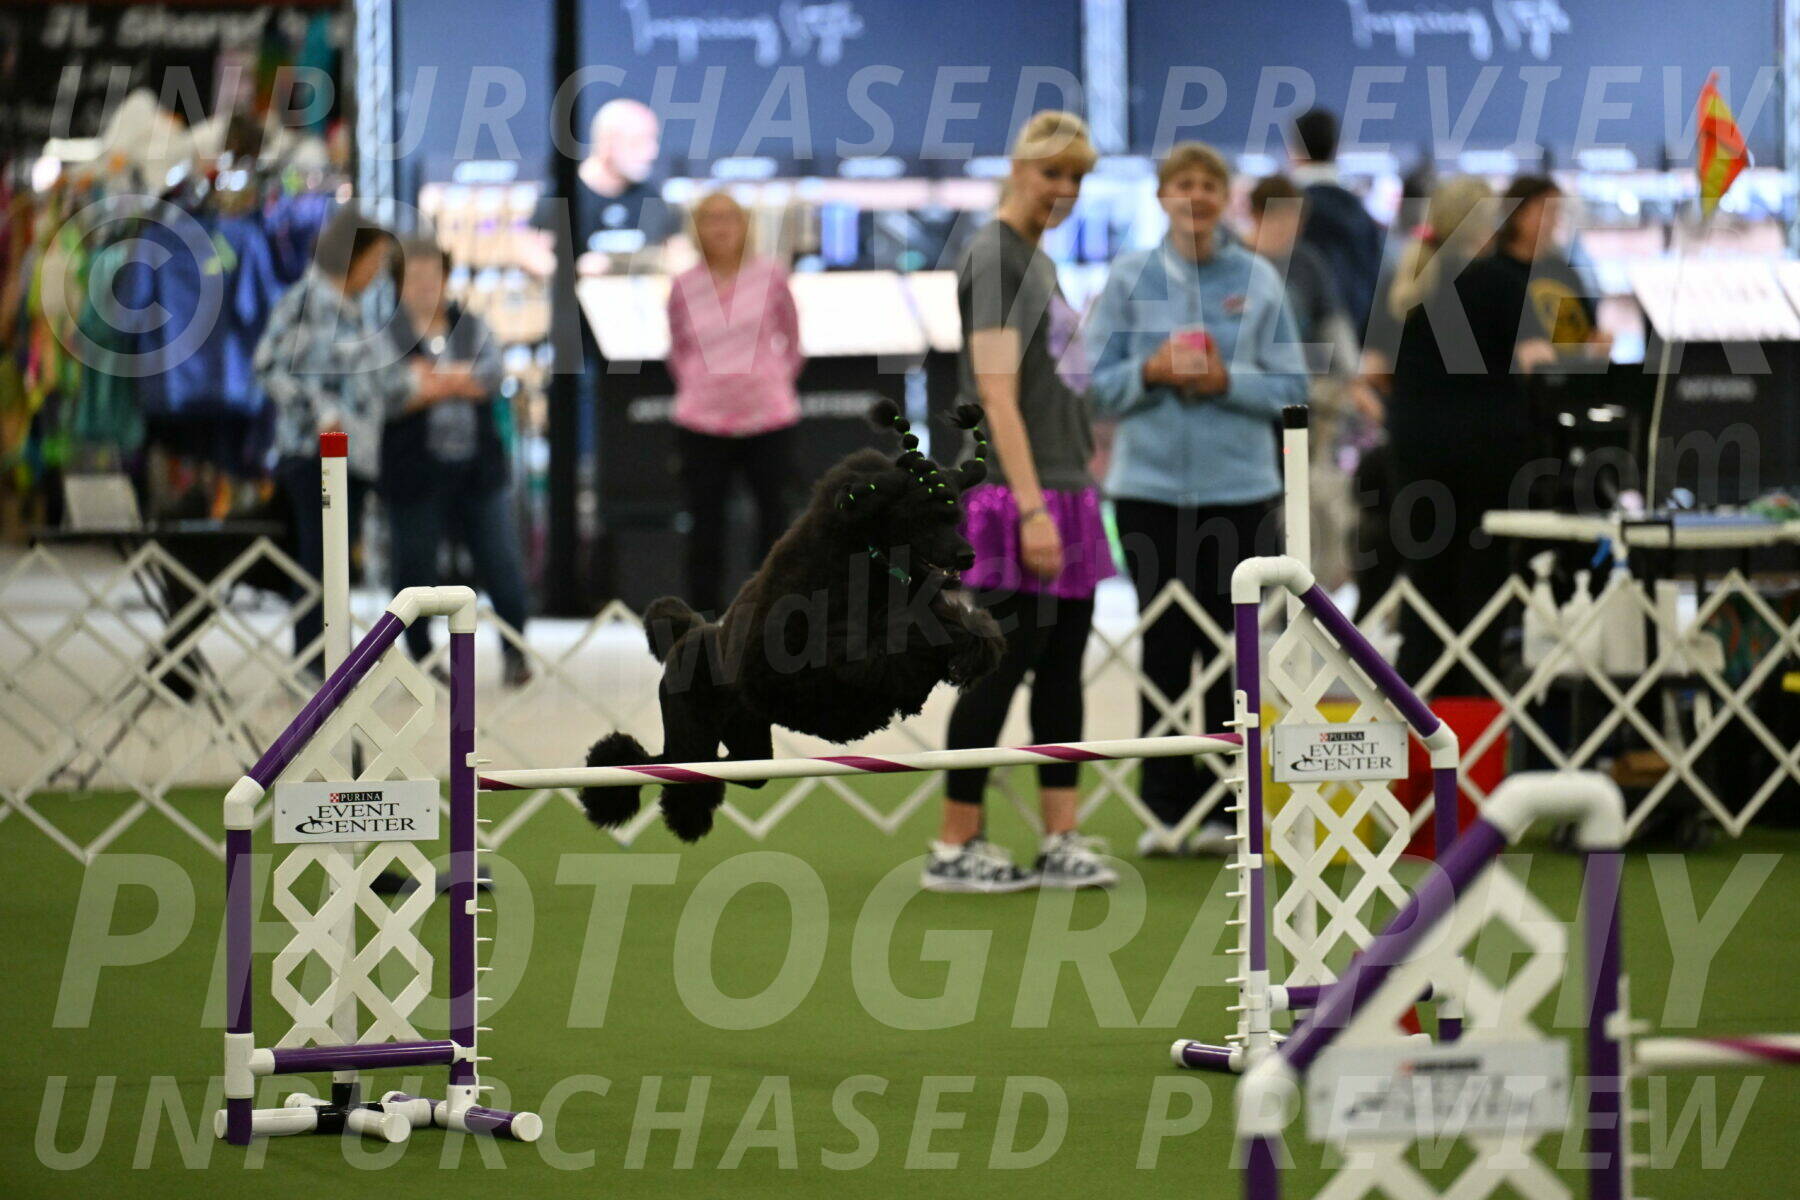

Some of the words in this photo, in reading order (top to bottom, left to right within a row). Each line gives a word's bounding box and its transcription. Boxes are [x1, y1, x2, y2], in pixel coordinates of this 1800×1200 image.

[1310, 742, 1378, 757] EVENT
[1290, 756, 1392, 772] CENTER
[341, 792, 382, 802] PURINA
[318, 803, 400, 818] EVENT
[295, 818, 417, 834] CENTER
